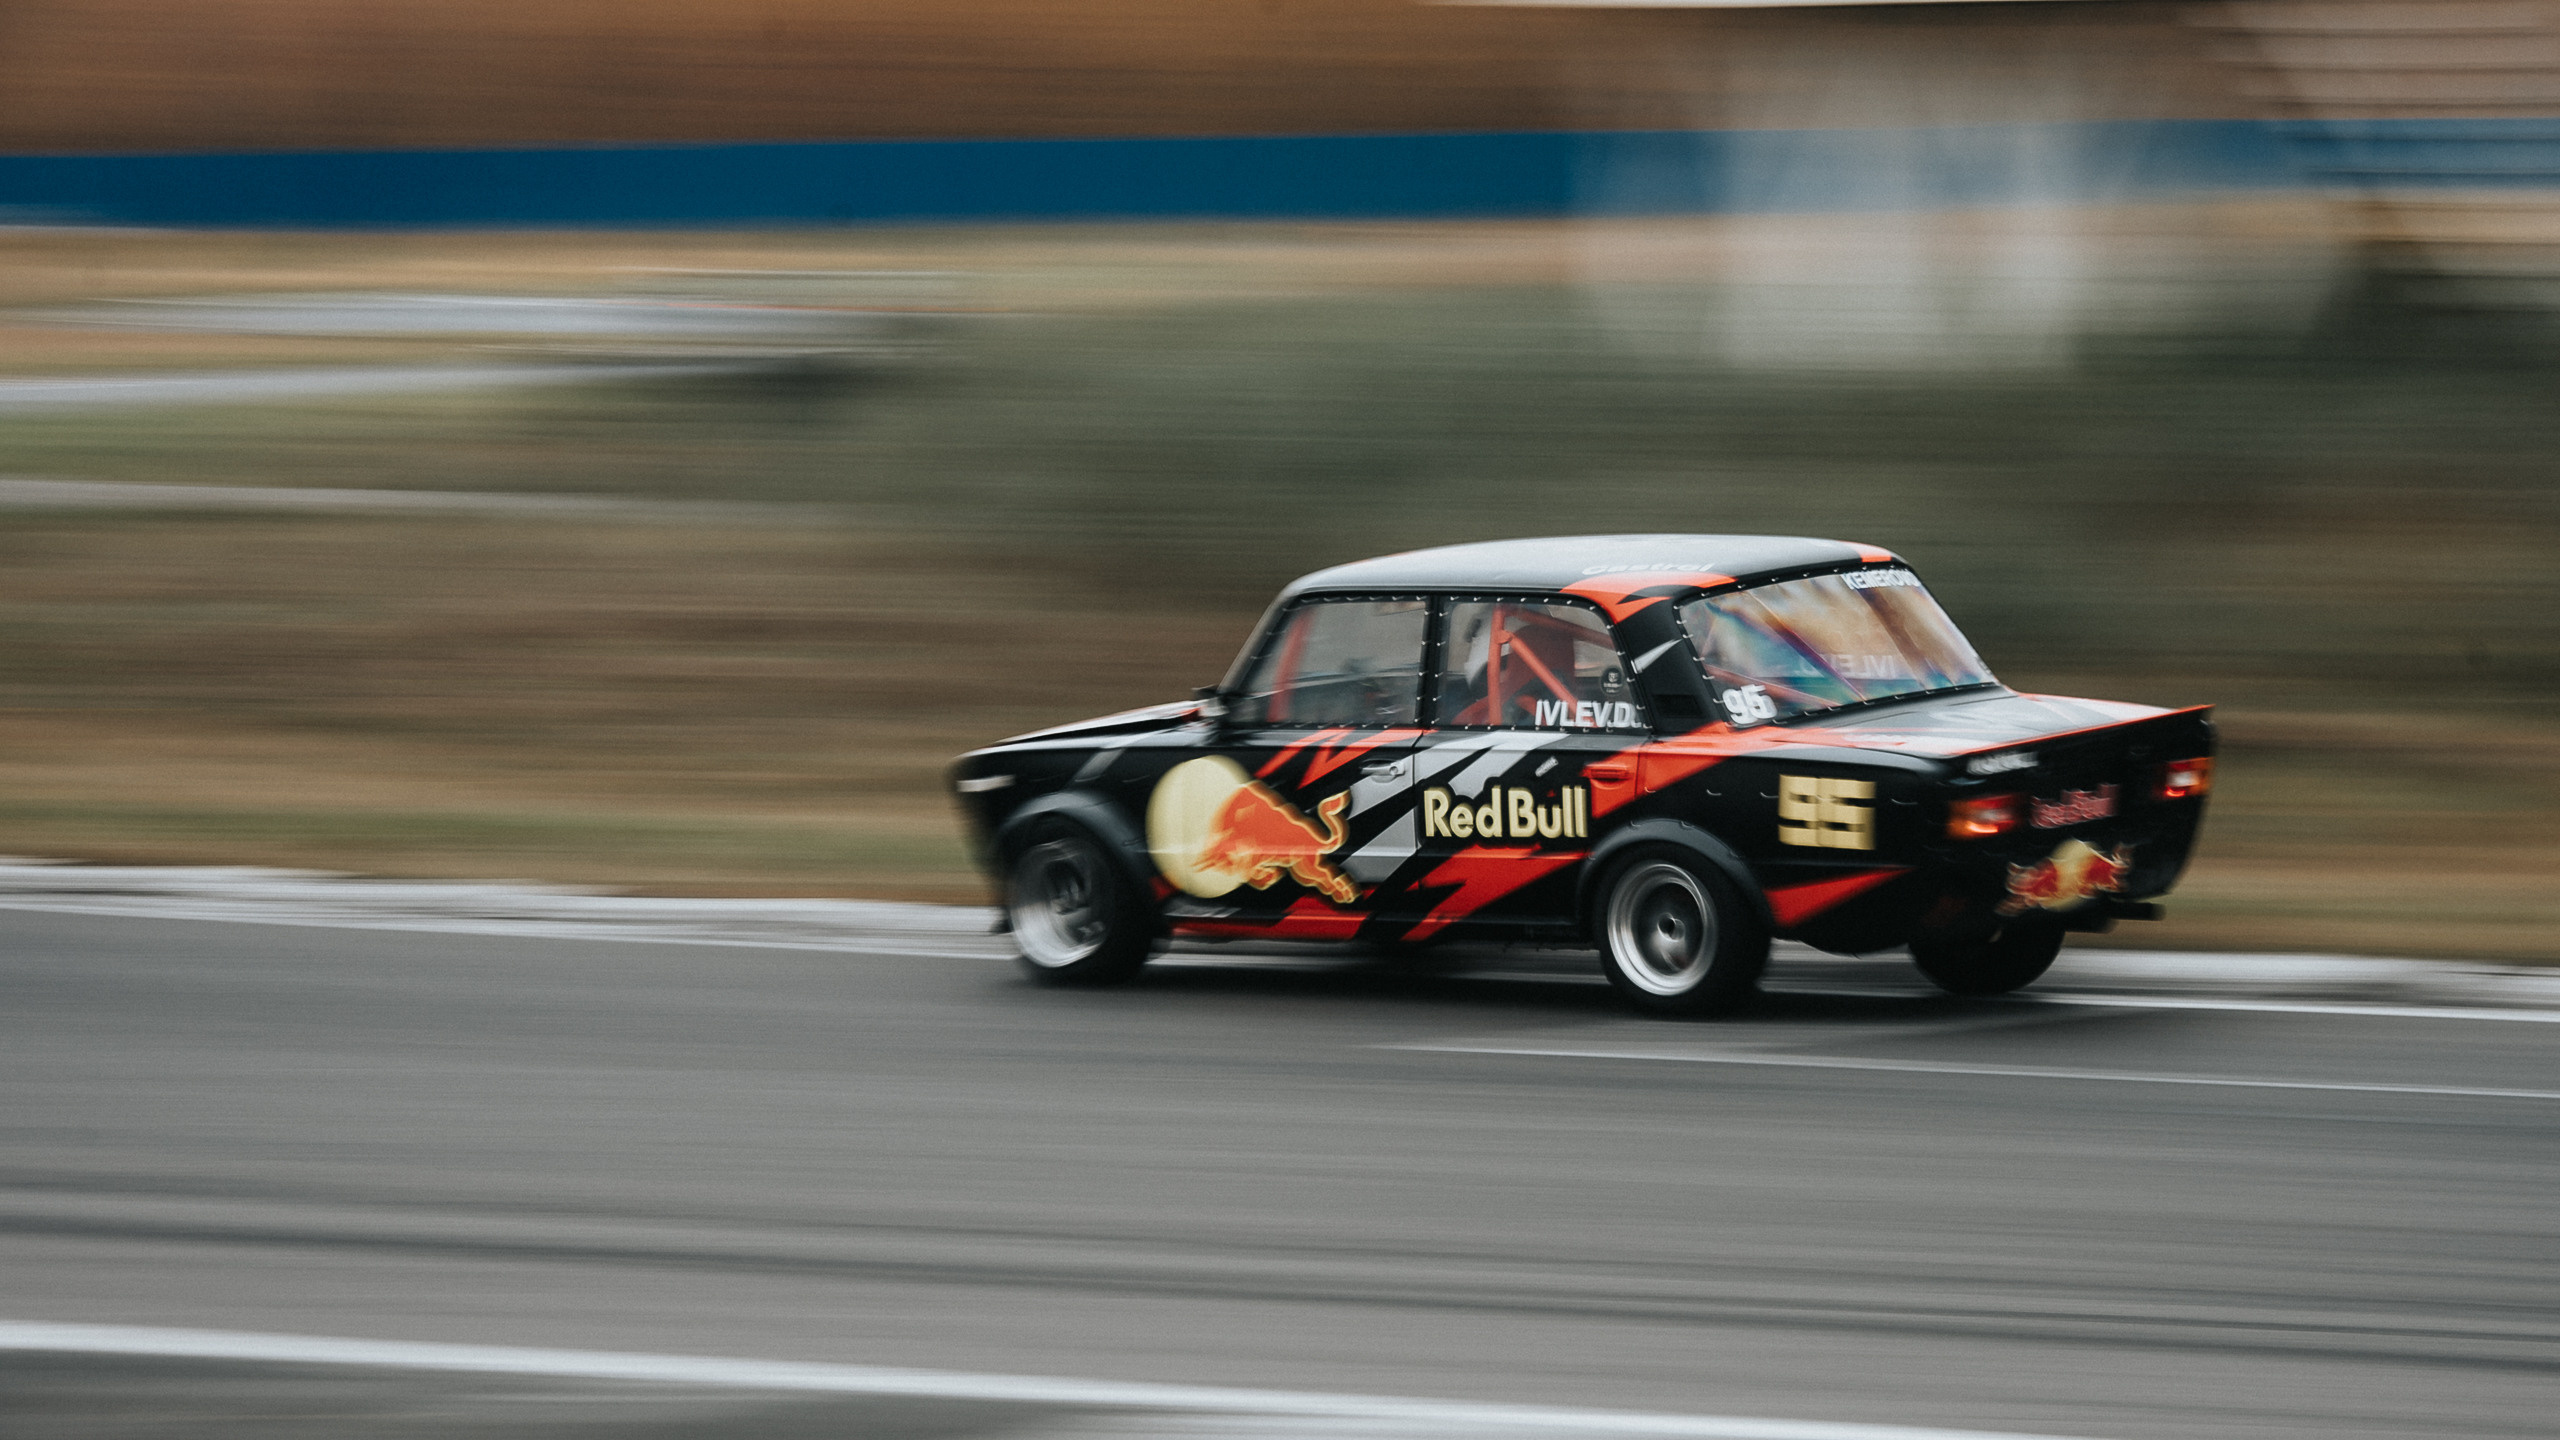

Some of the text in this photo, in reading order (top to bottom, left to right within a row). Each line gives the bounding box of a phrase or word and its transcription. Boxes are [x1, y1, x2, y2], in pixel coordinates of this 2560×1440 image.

[1722, 683, 1778, 725] 95
[1423, 785, 1589, 839] Red Bull
[1778, 774, 1876, 851] 95
